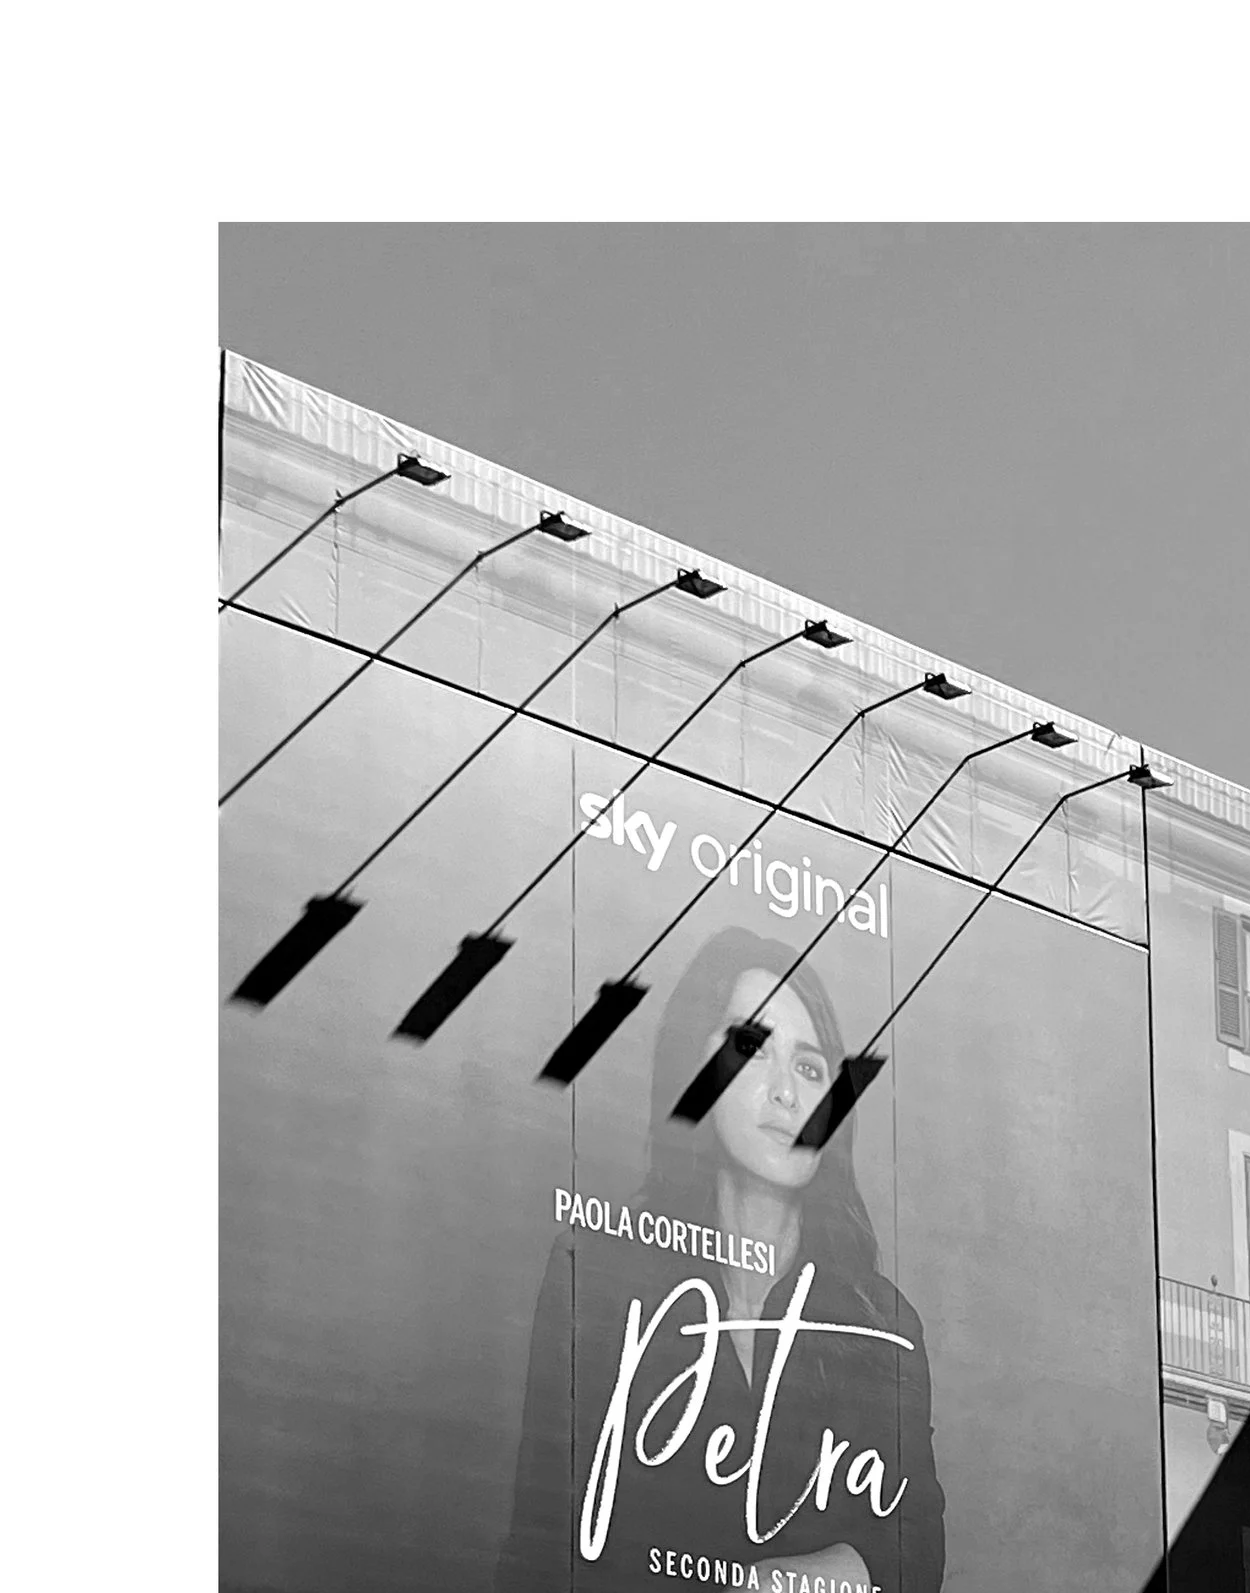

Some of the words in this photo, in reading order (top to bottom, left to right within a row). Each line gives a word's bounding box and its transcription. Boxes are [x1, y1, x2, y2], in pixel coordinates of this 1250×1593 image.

[578, 788, 678, 872] sky
[690, 834, 889, 939] original
[555, 1188, 634, 1240] PAOLA
[638, 1211, 776, 1276] CORTELLESI
[648, 1548, 760, 1591] SECONDA
